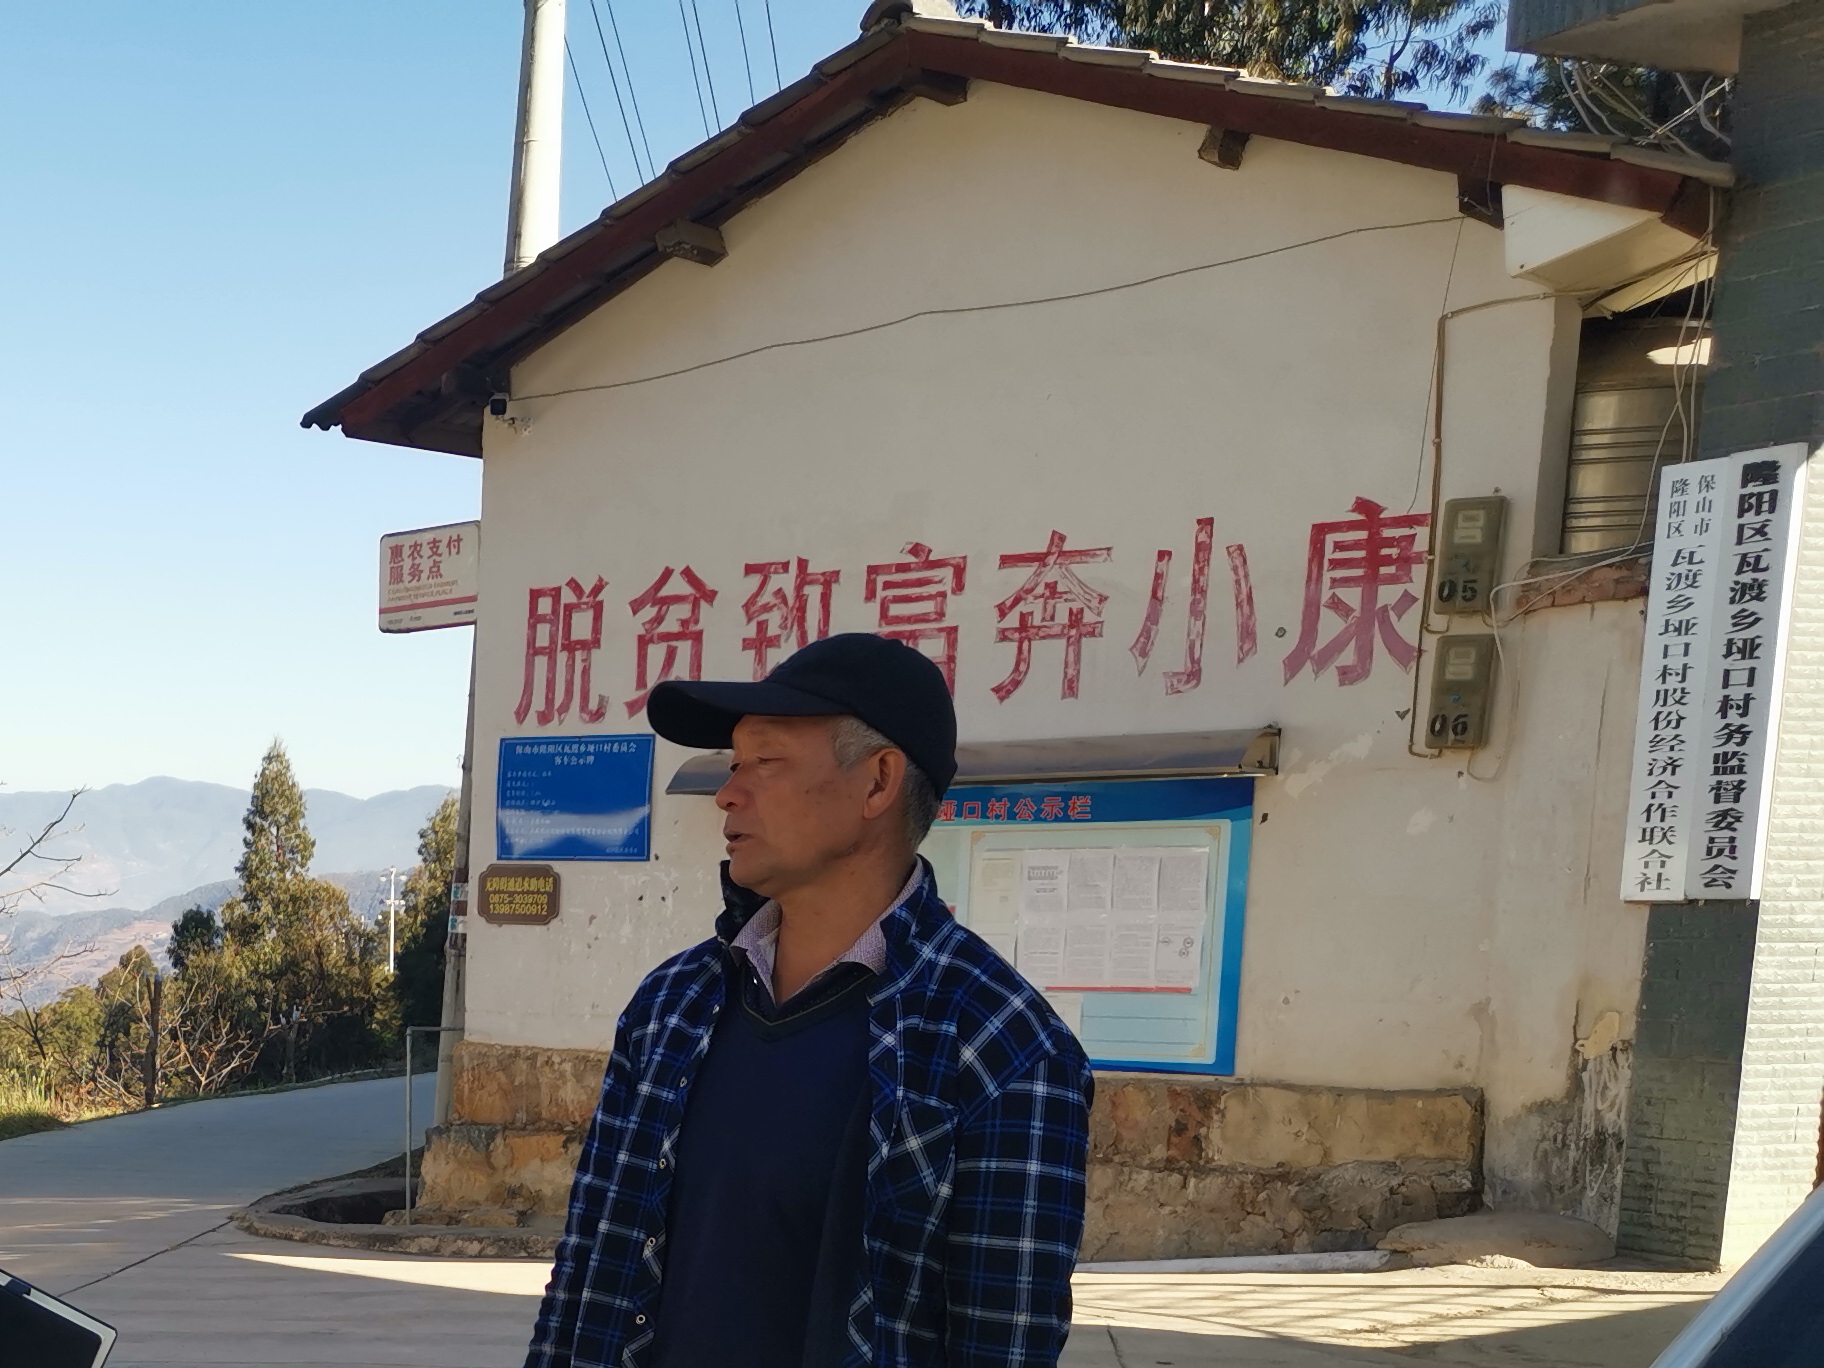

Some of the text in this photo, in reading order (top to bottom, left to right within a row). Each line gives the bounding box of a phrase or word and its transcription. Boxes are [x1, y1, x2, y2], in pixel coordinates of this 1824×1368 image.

[1665, 477, 1691, 539] 隆阳区
[1693, 474, 1717, 537] 保山市
[388, 533, 464, 566] 惠农支付
[388, 558, 443, 586] 服务点
[1438, 578, 1478, 603] 05
[512, 496, 1433, 730] 脱贫致富奔小康
[1699, 459, 1781, 890] 隆阳区瓦渡乡垭口村务监督委员会
[1429, 712, 1469, 737] 06
[1633, 544, 1706, 893] 瓦渡乡垭口村股份经济合作联合社
[936, 795, 1092, 822] 垭口村公示栏
[488, 893, 548, 904] 0875-3039709
[489, 903, 548, 915] 13987500912
